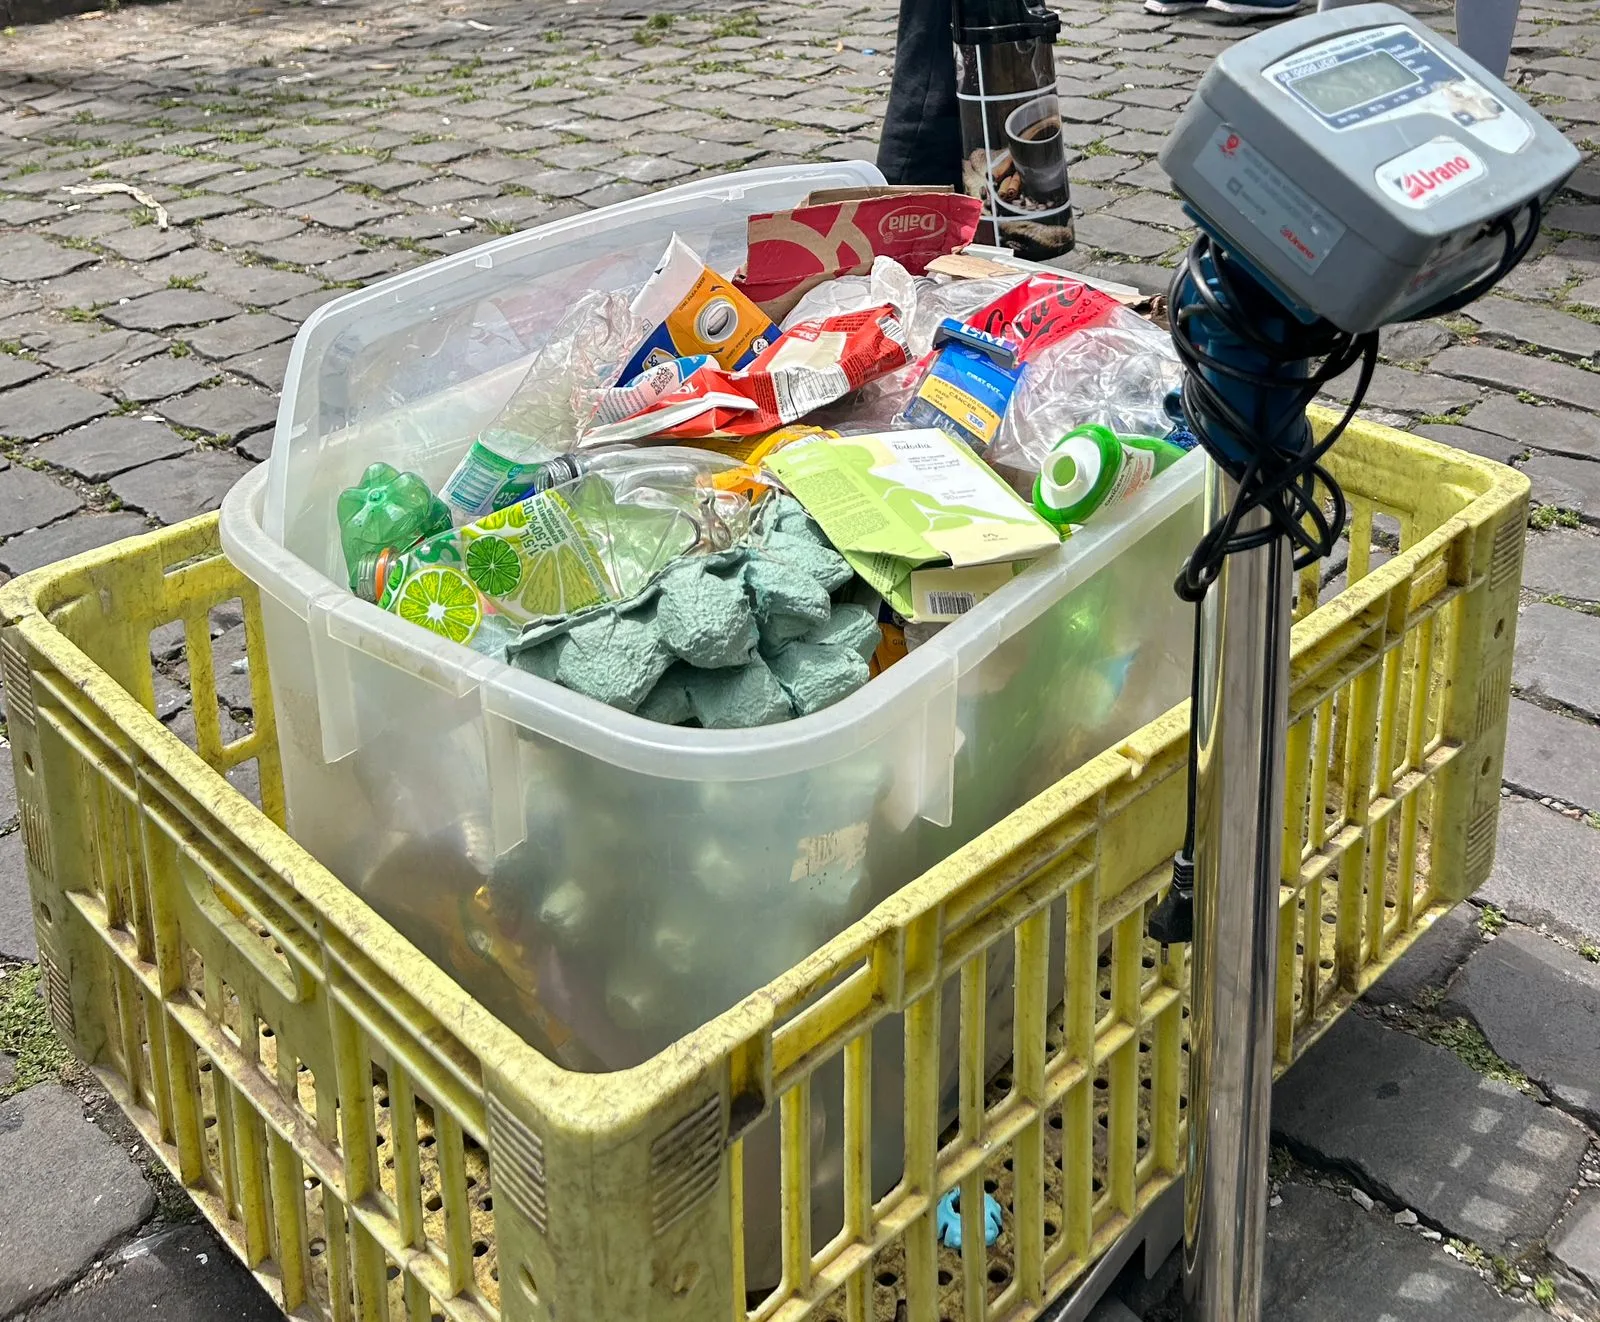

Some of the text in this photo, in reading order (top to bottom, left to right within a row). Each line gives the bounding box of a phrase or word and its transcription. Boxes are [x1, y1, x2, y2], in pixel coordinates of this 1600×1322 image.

[1410, 156, 1470, 190] Urano
[888, 213, 936, 232] Dália
[925, 394, 948, 410] FUMAR
[947, 389, 978, 412] CÂNCER
[948, 385, 977, 404] PRODUTO
[974, 402, 997, 418] CAUSA
[968, 413, 985, 428] 136
[522, 499, 553, 551] 2,50% DE
[538, 505, 561, 544] REFRIGERANTE
[545, 507, 568, 541] SEM AÇÚCAR
[519, 529, 539, 557] 1,5 L
